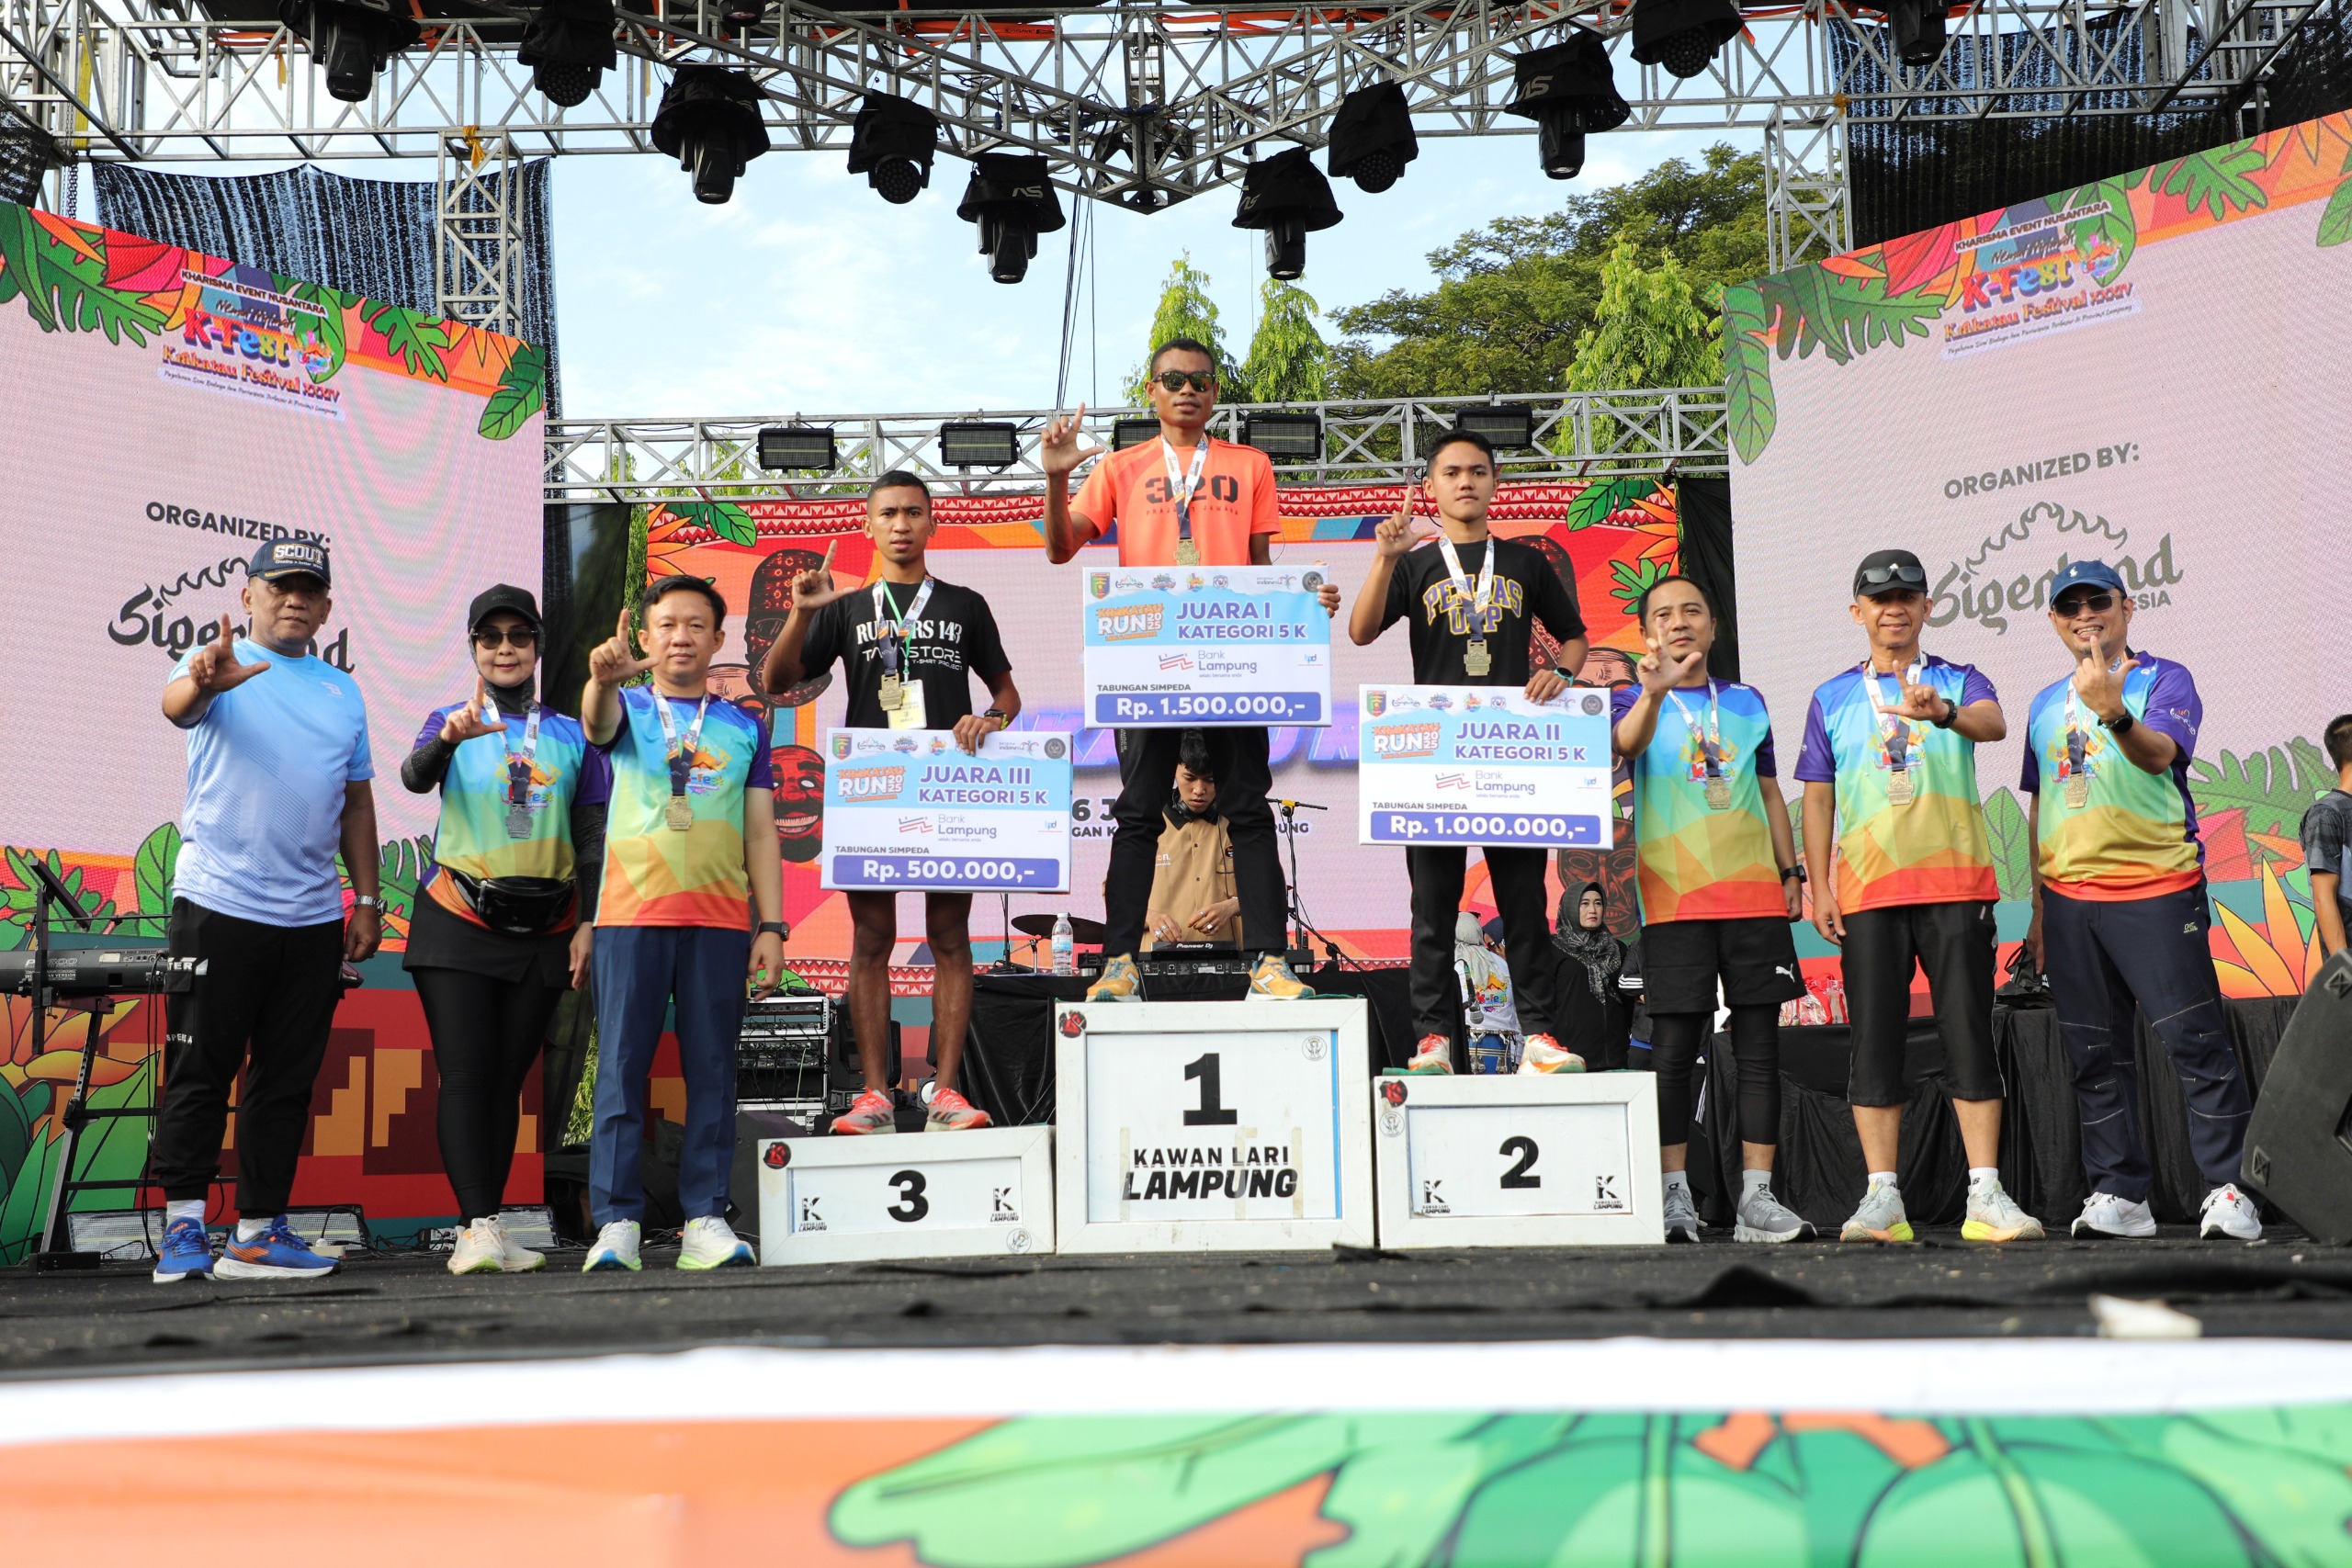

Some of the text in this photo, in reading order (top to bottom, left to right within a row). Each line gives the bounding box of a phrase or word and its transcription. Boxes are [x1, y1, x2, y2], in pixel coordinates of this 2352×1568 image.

[1955, 201, 2109, 252] KHARISMA EVENT NUSANTARA
[182, 270, 326, 316] KHARISMA EVENT NUSANTARA
[1961, 258, 2075, 313] K-Fest
[1944, 310, 2019, 342] Krakatau
[2022, 288, 2088, 321] Festival
[184, 307, 290, 367] K-Fest
[163, 344, 238, 379] Krakatau
[241, 363, 300, 394] Festival
[1944, 442, 2140, 499] ORGANIZED BY:
[145, 502, 288, 542] ORGANIZED
[274, 544, 323, 566] SCOUT
[1176, 602, 1271, 620] JUARA I
[1422, 574, 1523, 626] PEAS
[1098, 613, 1162, 636] RUN 20
[1148, 621, 1162, 630] 25
[1178, 625, 1306, 638] KATEGORI 5 K
[1449, 605, 1503, 636] UP
[856, 619, 963, 645] RUNRS 143
[1198, 650, 1225, 660] Bank
[1198, 660, 1257, 674] Lampung
[1150, 683, 1191, 692] SIMPEDA
[1116, 696, 1306, 720] Rp. 1.500.000,-
[1374, 731, 1439, 753] RUN 20
[1455, 723, 1560, 741] JUARA II
[1424, 739, 1439, 750] 25
[1455, 745, 1586, 761] KATEGORI 5 K
[838, 775, 903, 796] RUN 20
[921, 766, 1031, 784] JUARA III
[1476, 770, 1503, 780] Bank
[888, 784, 902, 793] 25
[919, 788, 1047, 804] KATEGORI 5 K
[1476, 781, 1535, 795] Lampung
[1373, 802, 1468, 810] TABUNGAN SIMPEDA
[938, 814, 966, 823] Bank
[1390, 815, 1586, 840] Rp. 1.000.000,-
[938, 825, 997, 839] Lampung
[835, 845, 930, 854] TABUNGAN SIMPEDA
[864, 860, 1035, 883] Rp. 500.000,-
[1183, 1053, 1238, 1126] 1
[1134, 1145, 1289, 1168] KAWAN LARI
[1498, 1135, 1541, 1189] 2
[1122, 1168, 1298, 1201] LAMPUNG
[887, 1169, 929, 1223] 3
